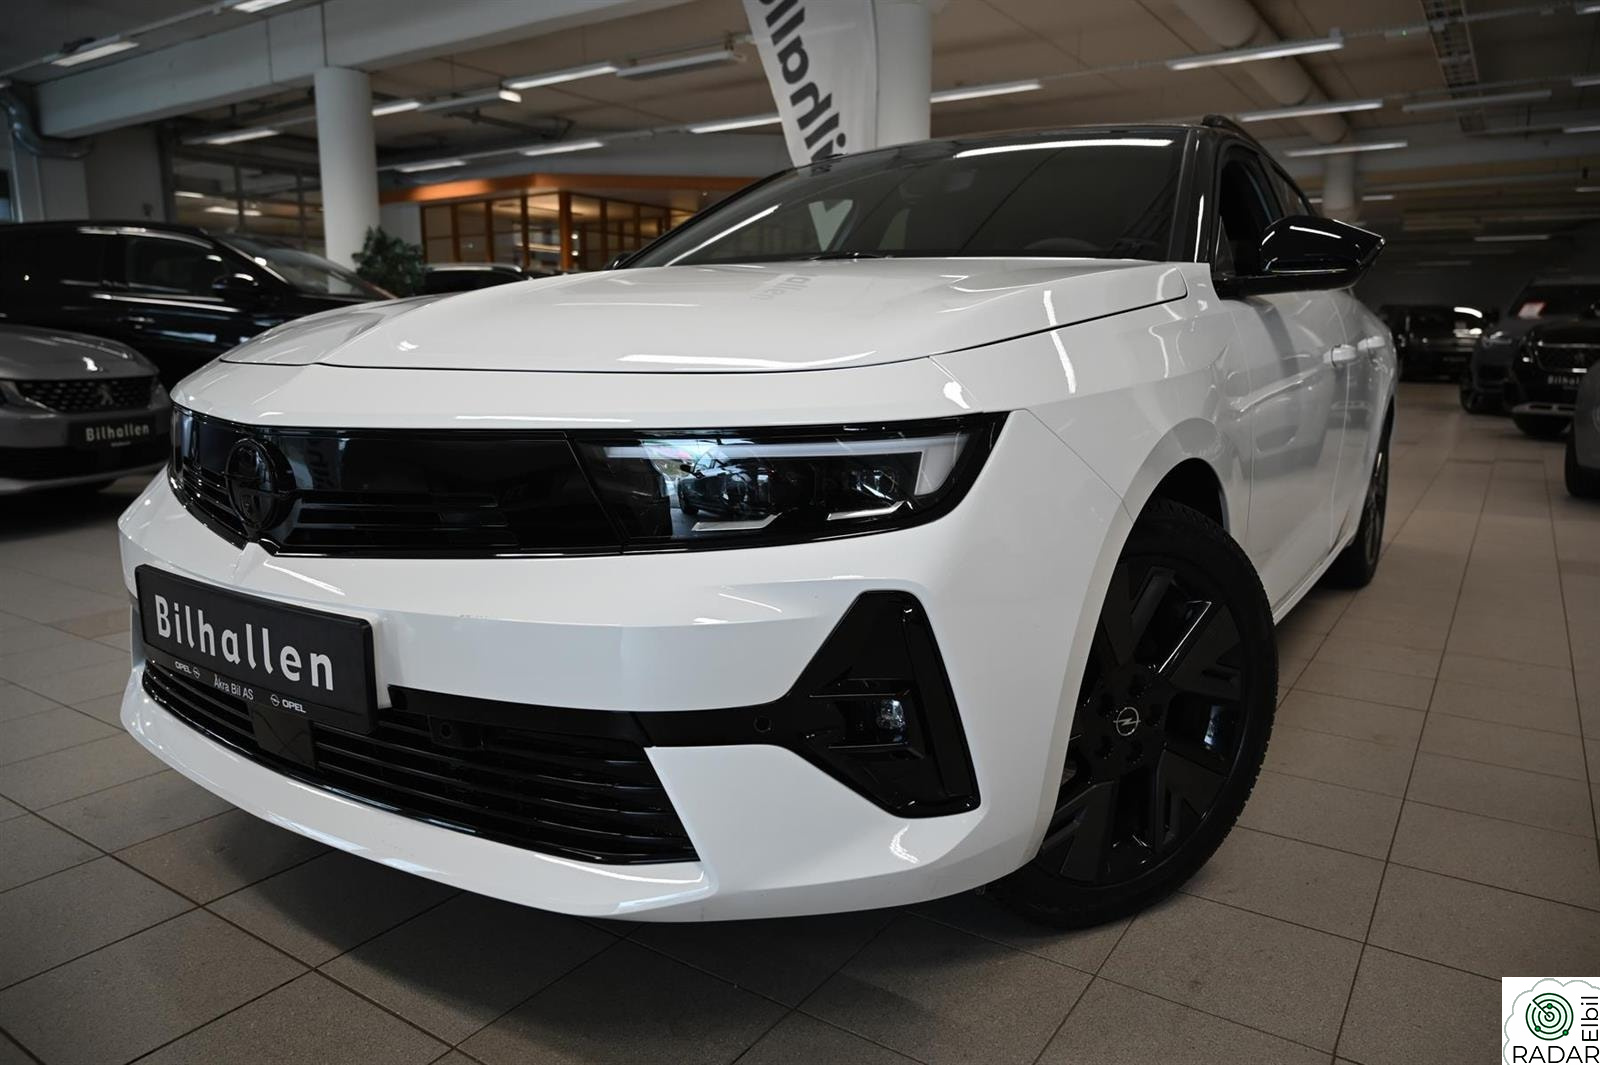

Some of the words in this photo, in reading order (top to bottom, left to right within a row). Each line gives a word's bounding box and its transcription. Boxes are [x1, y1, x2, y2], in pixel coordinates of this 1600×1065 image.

[85, 424, 149, 442] Bilhallen
[154, 594, 334, 691] Bilhallen
[174, 661, 192, 674] OPEL
[231, 682, 241, 696] Bil
[242, 687, 254, 701] AS
[282, 699, 307, 713] OPEL
